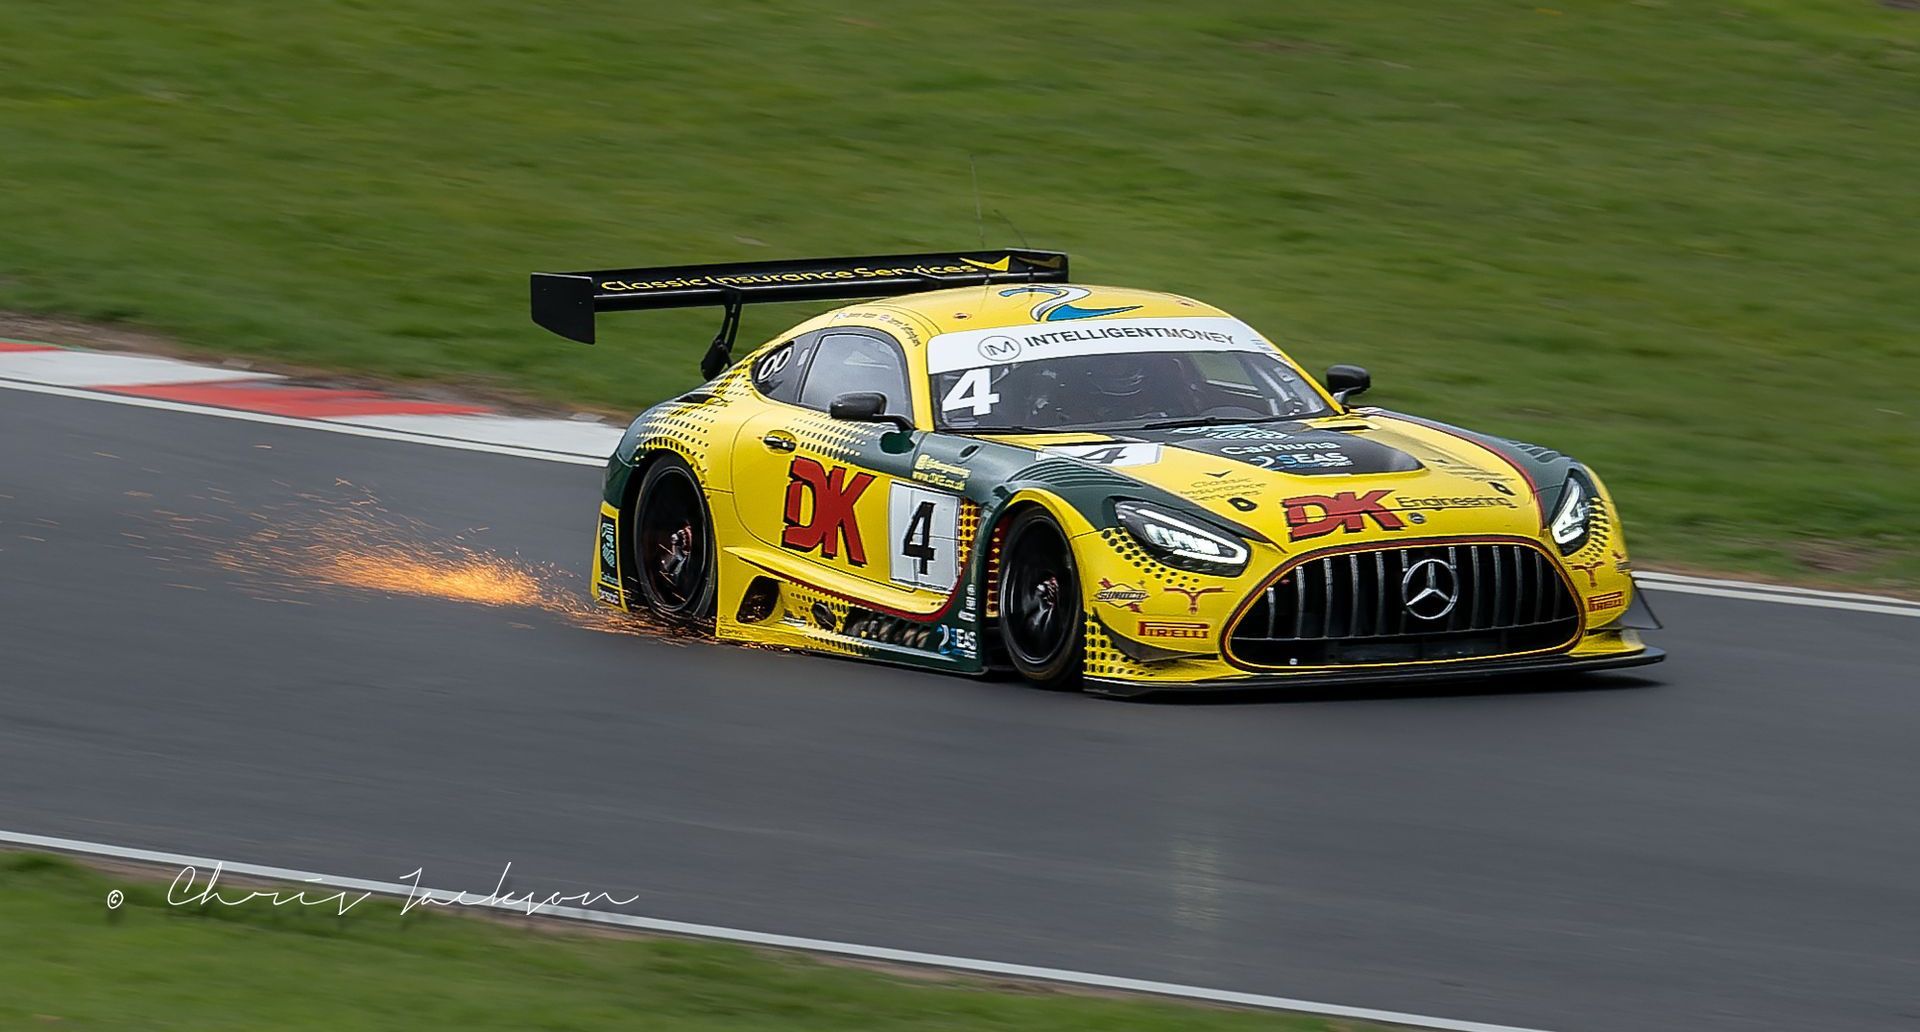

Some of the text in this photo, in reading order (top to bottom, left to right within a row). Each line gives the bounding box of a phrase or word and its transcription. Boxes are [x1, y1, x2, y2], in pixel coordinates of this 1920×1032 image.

[601, 265, 978, 290] Classic Insurance Services
[1024, 327, 1235, 347] INTELLIGENTMONEY
[942, 367, 1000, 416] 4
[781, 456, 876, 567] DK
[1282, 490, 1518, 542] DK Engineering
[903, 501, 937, 576] 4
[1138, 621, 1210, 638] PIRELLI
